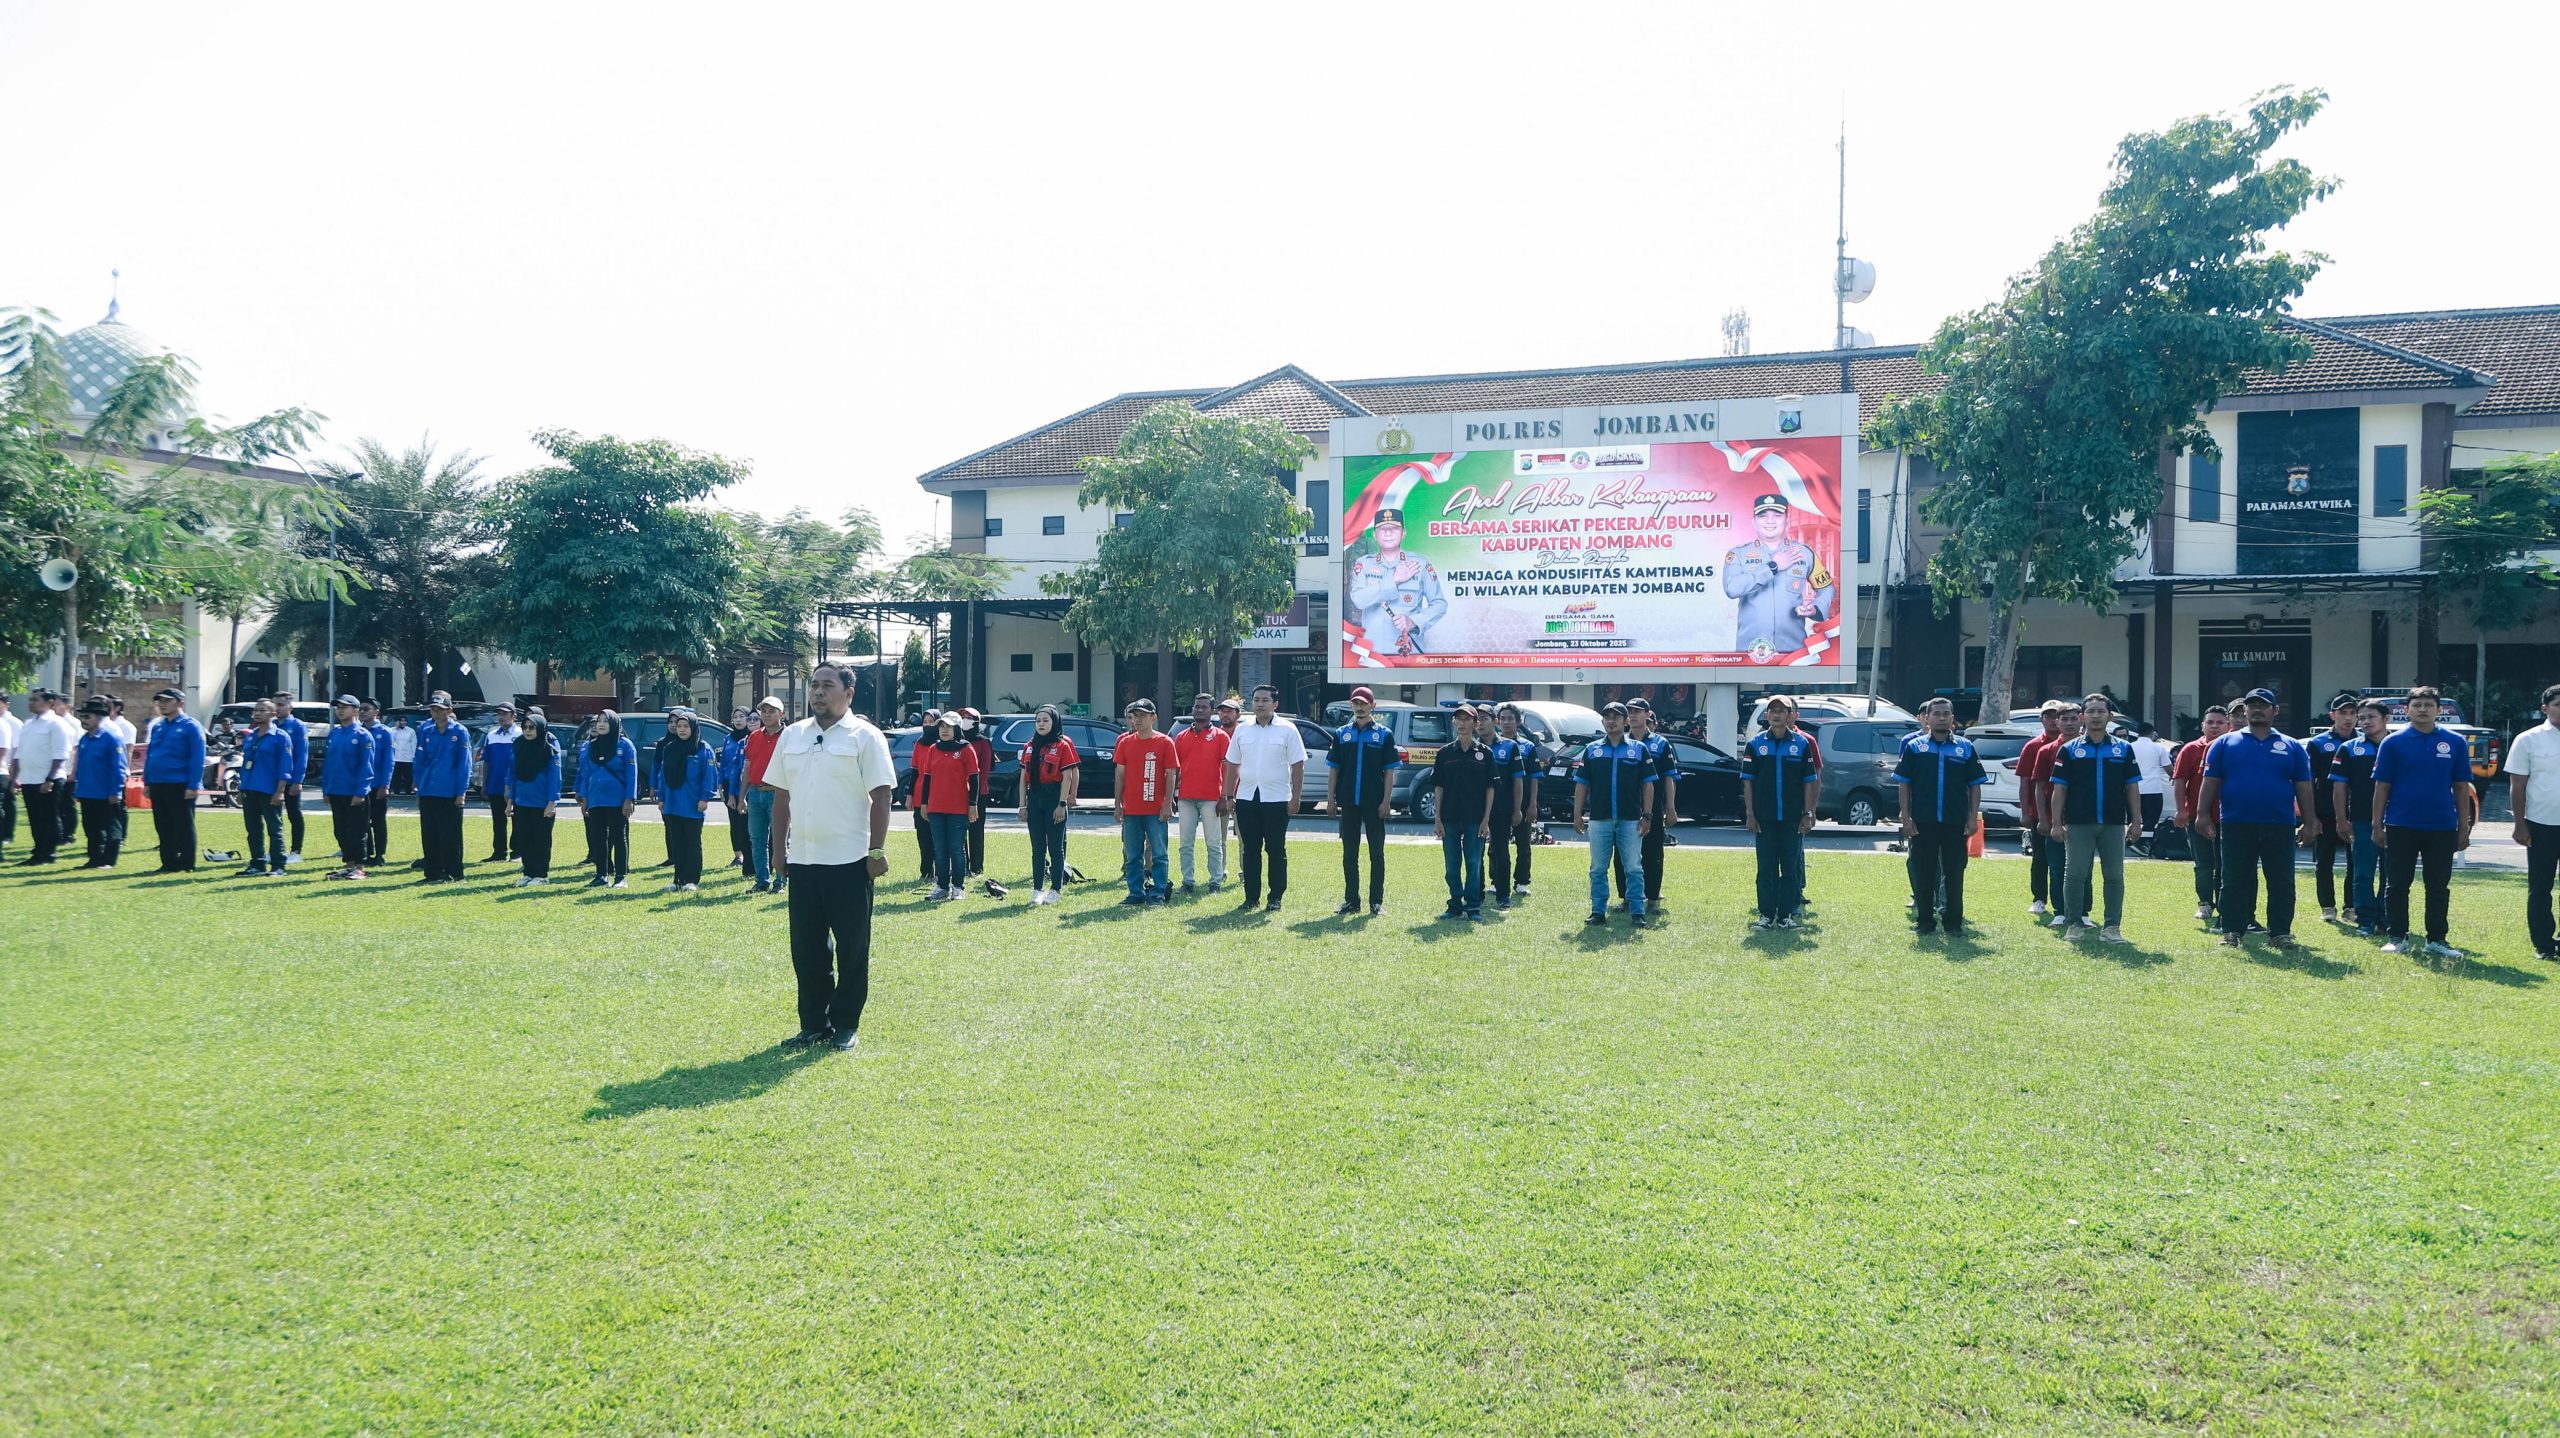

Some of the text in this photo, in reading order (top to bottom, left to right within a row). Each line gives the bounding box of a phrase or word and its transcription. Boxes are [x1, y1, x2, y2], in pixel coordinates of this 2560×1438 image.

[1465, 412, 1716, 441] POLRES JOMBANG
[1442, 475, 1717, 523] Apel Akbar Kebangsaan
[2246, 499, 2352, 512] PARAMASATWIKA
[1430, 513, 1730, 537] BERSAMA SERIKAT PEKERJA/BURUH
[1481, 533, 1673, 552] KABUPATEN JOMBANG
[1534, 549, 1580, 568] Dalam
[1447, 566, 1714, 582] MENJAGA KONDUSIFITAS KAMTIBMAS
[1455, 582, 1705, 597] DI WILAYAH KABUPATEN JOMBANG
[1264, 615, 1288, 625] TUK
[1545, 620, 1615, 634] JOGO JOMBANG
[1535, 640, 1569, 649] Jombang,
[1609, 639, 1627, 647] 2025
[1695, 655, 1743, 663] KOMUNIKATIF
[2222, 651, 2287, 661] SAT SAMAPTA
